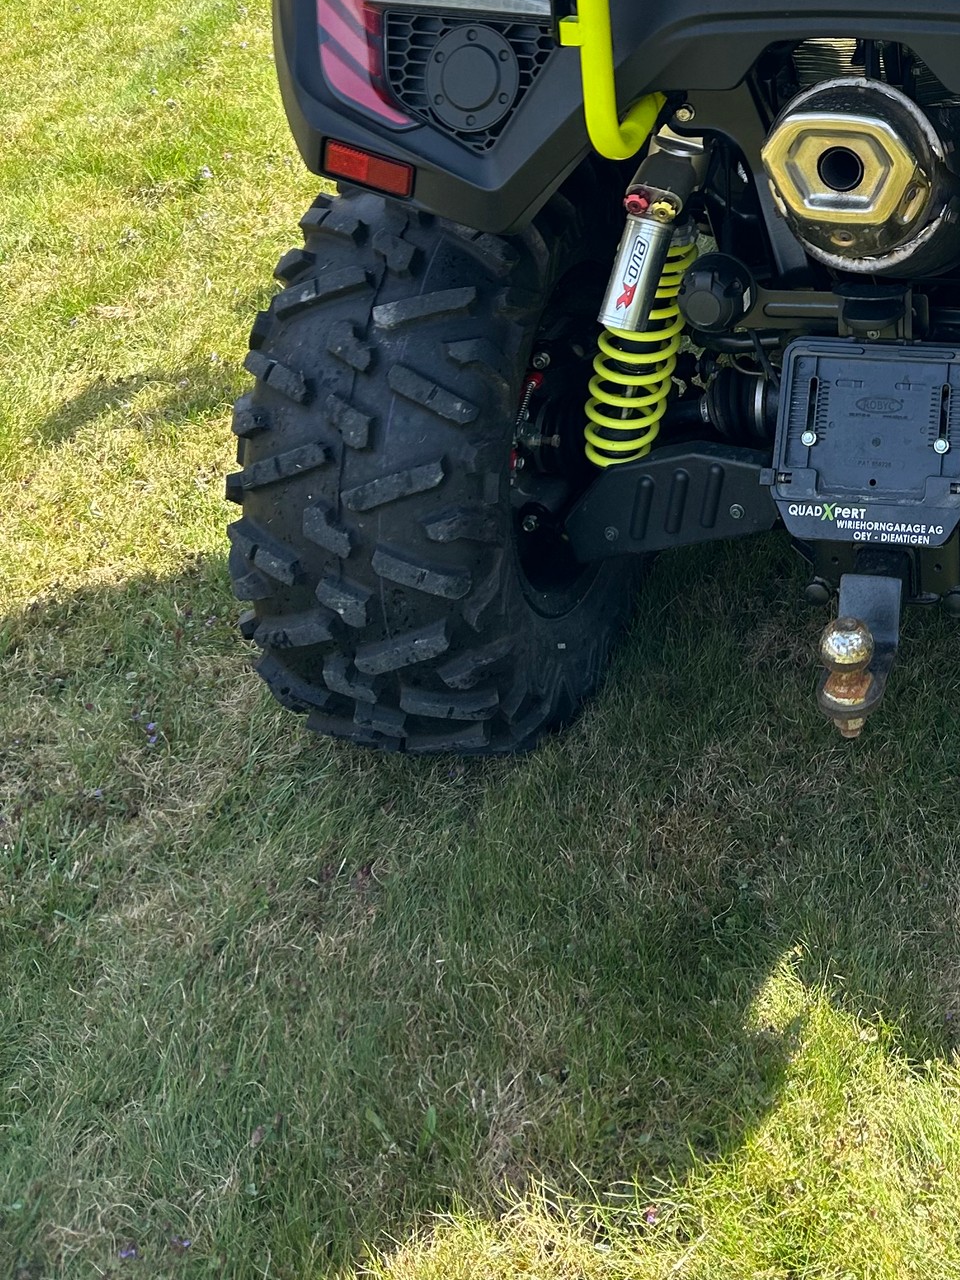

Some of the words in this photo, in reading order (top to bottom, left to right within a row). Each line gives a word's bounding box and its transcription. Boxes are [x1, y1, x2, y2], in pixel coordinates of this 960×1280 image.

[836, 520, 926, 534] WIRIEHORNGARAGE
[928, 525, 943, 535] AG
[853, 531, 872, 541] OEY
[880, 532, 930, 545] DIEMTIGEN
